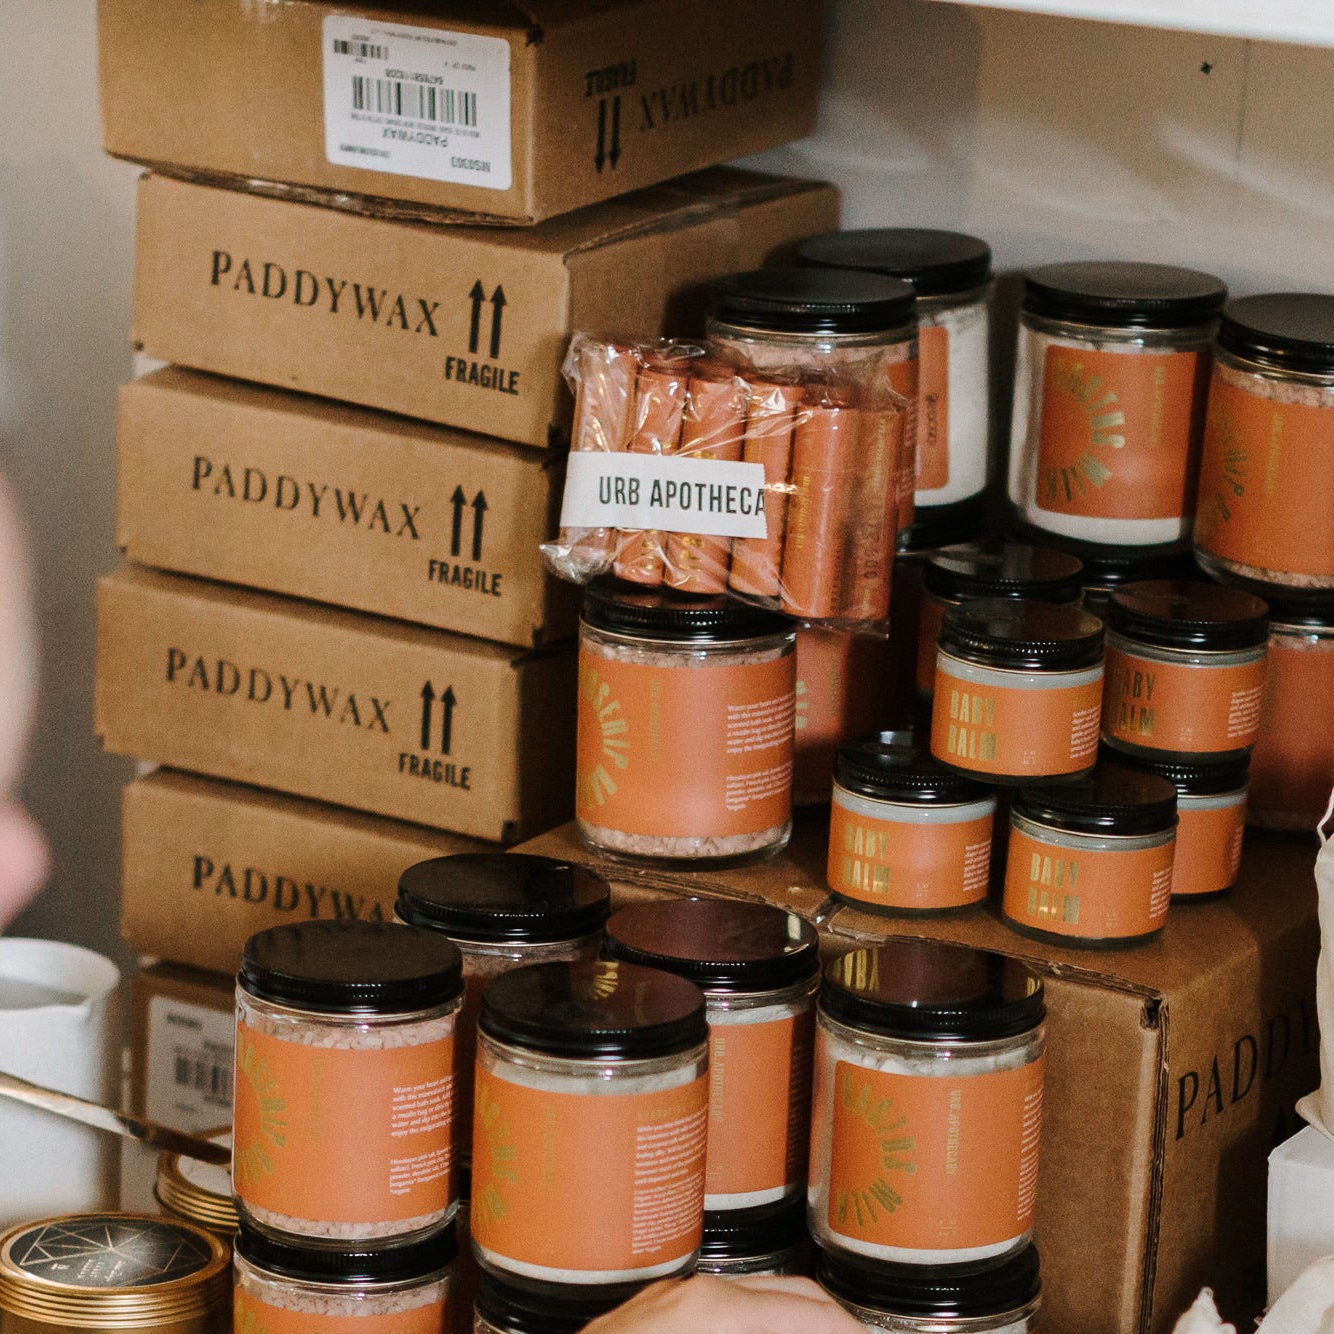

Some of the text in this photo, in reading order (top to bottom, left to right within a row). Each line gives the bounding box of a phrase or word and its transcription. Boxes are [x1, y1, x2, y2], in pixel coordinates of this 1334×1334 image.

[381, 127, 449, 147] PADDYWAX
[210, 250, 440, 338] PADDYWAX
[445, 356, 519, 395] FRAGILE
[192, 456, 422, 541] PADDYWAX
[598, 475, 641, 506] URB
[649, 479, 765, 517] APOTHECA
[428, 558, 503, 598] FRAGILE
[166, 648, 394, 735] PADDYWAX
[950, 690, 998, 727] BABY
[948, 727, 998, 761] BALM
[398, 752, 472, 792] FRAGILE
[844, 823, 890, 860] BABY
[193, 855, 385, 921] PADDYWA
[842, 859, 890, 894] BALM
[1031, 852, 1080, 888] BABY
[1027, 887, 1080, 925] BALM
